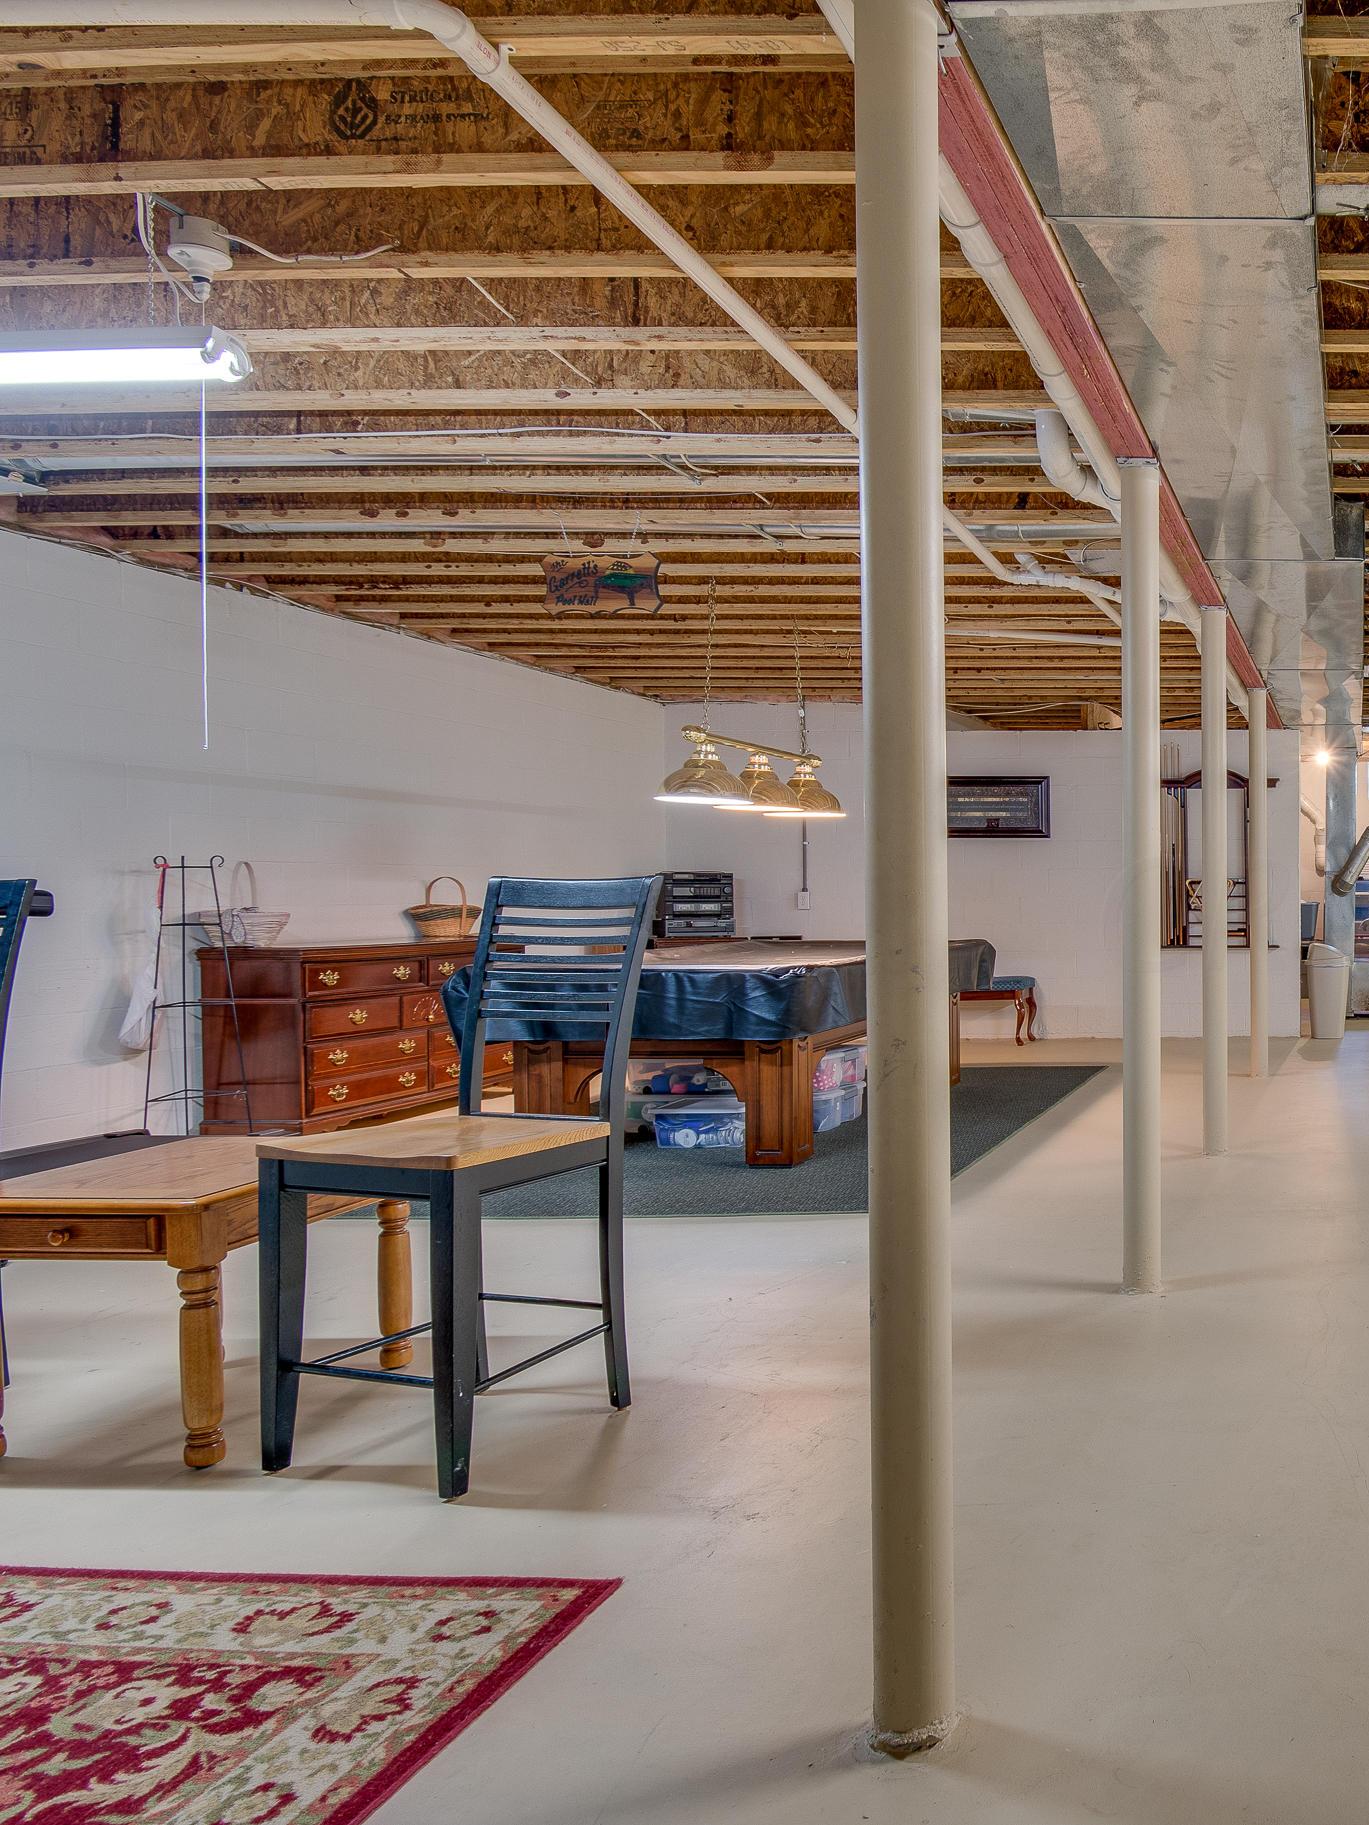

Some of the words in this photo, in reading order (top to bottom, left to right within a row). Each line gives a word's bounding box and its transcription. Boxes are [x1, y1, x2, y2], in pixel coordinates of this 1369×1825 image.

[404, 112, 442, 124] FRAME
[445, 112, 491, 123] SYSTEM
[549, 560, 599, 594] Garrett's
[555, 593, 576, 606] Pool
[577, 593, 598, 606] Hall
